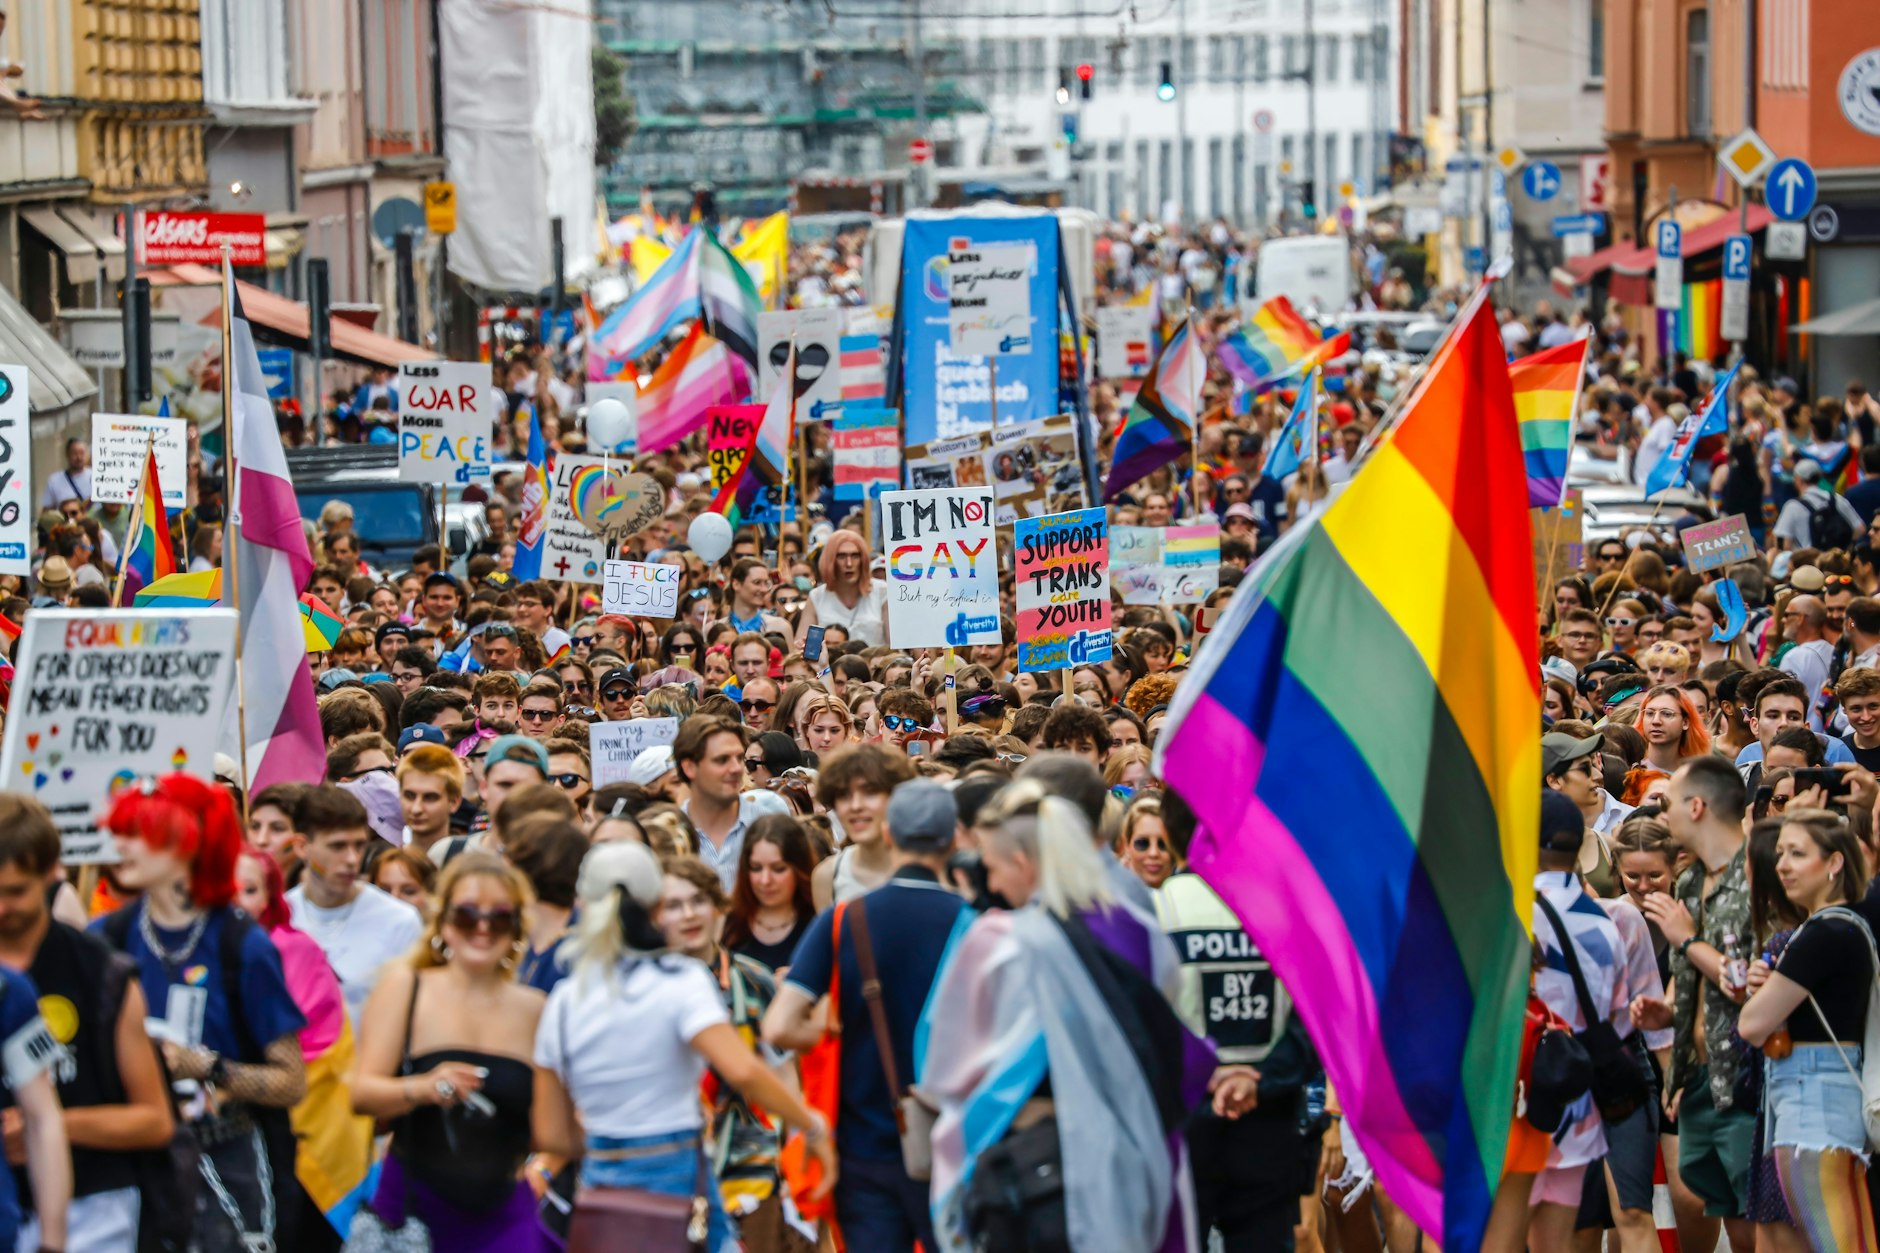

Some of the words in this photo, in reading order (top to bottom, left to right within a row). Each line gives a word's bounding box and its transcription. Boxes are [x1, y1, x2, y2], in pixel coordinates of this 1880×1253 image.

[408, 384, 477, 413] WAR
[402, 415, 443, 428] MORE
[402, 431, 486, 462] PEACE
[888, 499, 939, 541] I'M
[947, 496, 993, 529] NOT
[1021, 521, 1103, 565] SUPPORT
[606, 563, 621, 577] I
[628, 564, 678, 583] FUCK
[890, 538, 989, 581] GAY
[1029, 561, 1102, 595] TRANS
[607, 581, 676, 608] JESUS
[899, 584, 921, 603] But
[926, 594, 939, 608] my
[1051, 591, 1079, 603] care
[1036, 598, 1102, 630] YOUTH
[65, 619, 124, 648] EQUAL
[33, 652, 70, 681] FOR
[75, 652, 136, 681] OTHERS
[26, 685, 82, 716] MEAN
[89, 685, 147, 714] FEWER
[151, 685, 210, 716] RIGHTS
[71, 717, 111, 750] FOR
[117, 722, 156, 753] YOU
[599, 738, 630, 751] PRINCE
[618, 726, 643, 743] my
[1223, 972, 1255, 998] BY
[1209, 994, 1268, 1022] 5432
